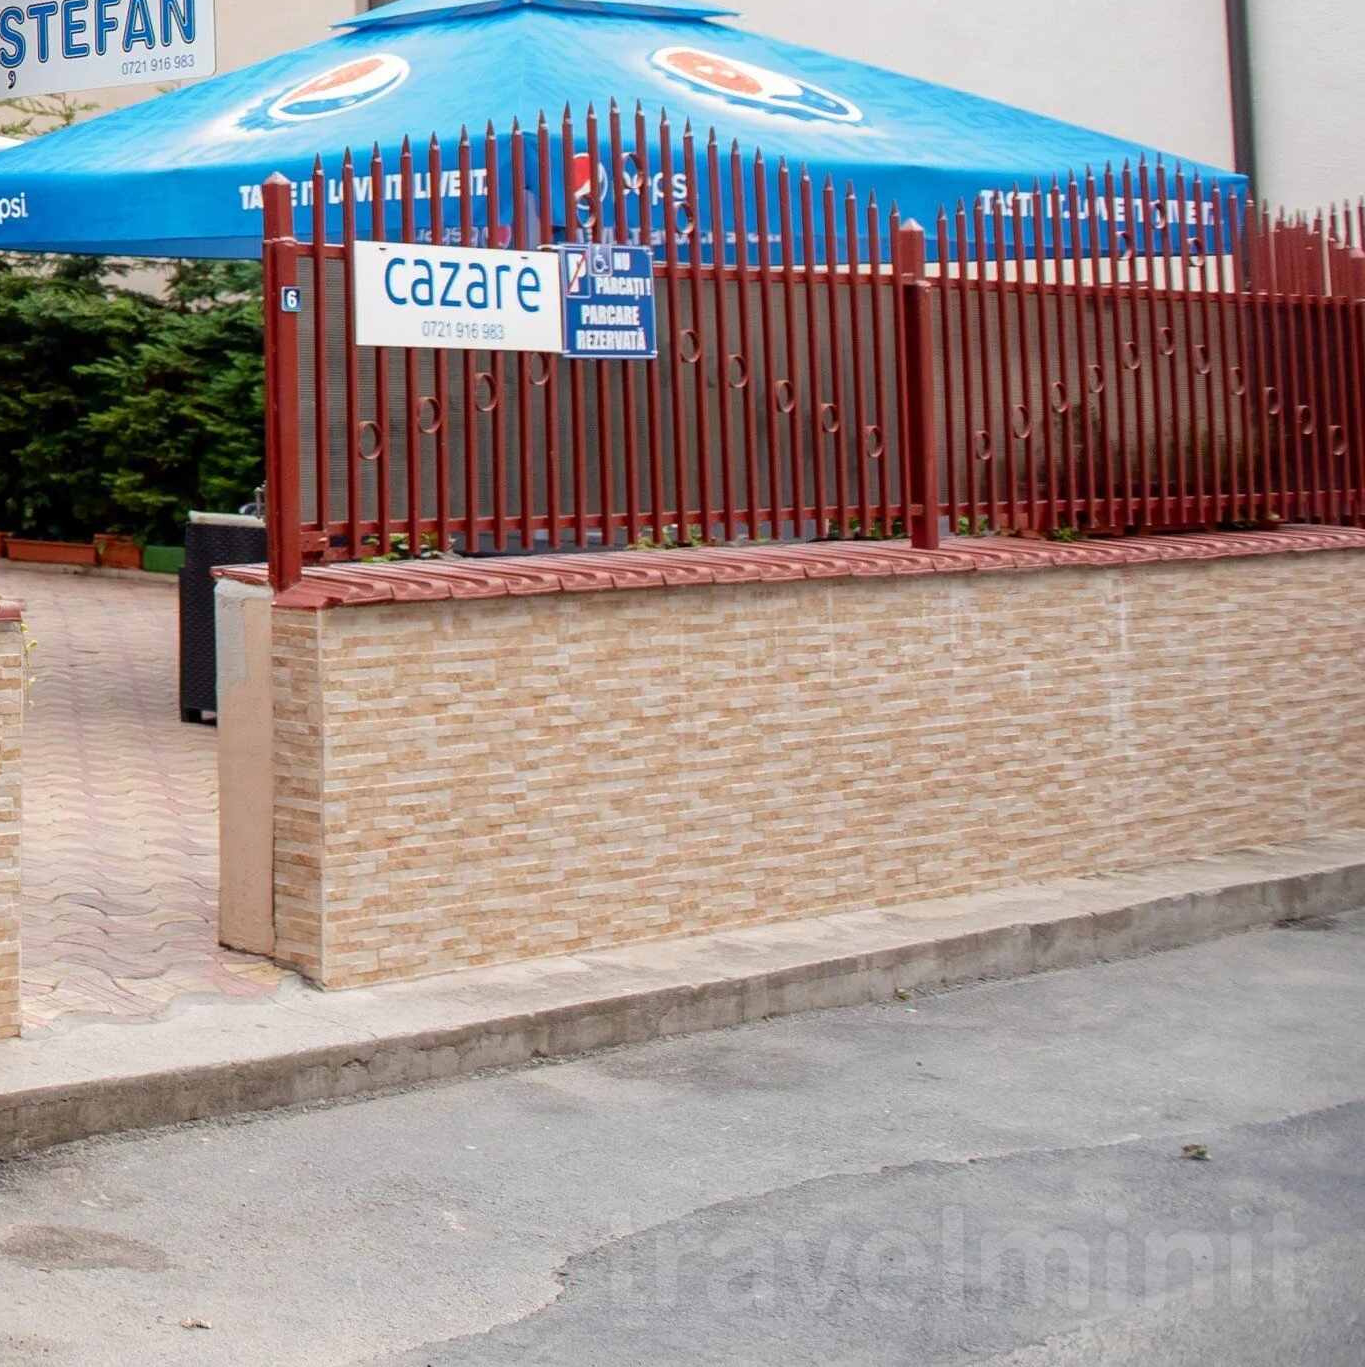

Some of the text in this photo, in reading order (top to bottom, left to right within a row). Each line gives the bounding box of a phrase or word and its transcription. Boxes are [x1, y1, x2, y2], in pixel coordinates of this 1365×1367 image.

[121, 54, 195, 76] 0721 916 983
[613, 251, 631, 271] NU
[384, 257, 541, 313] cazare
[285, 290, 297, 308] 6
[581, 304, 640, 325] PARCARE
[422, 320, 505, 340] 0721 916 983
